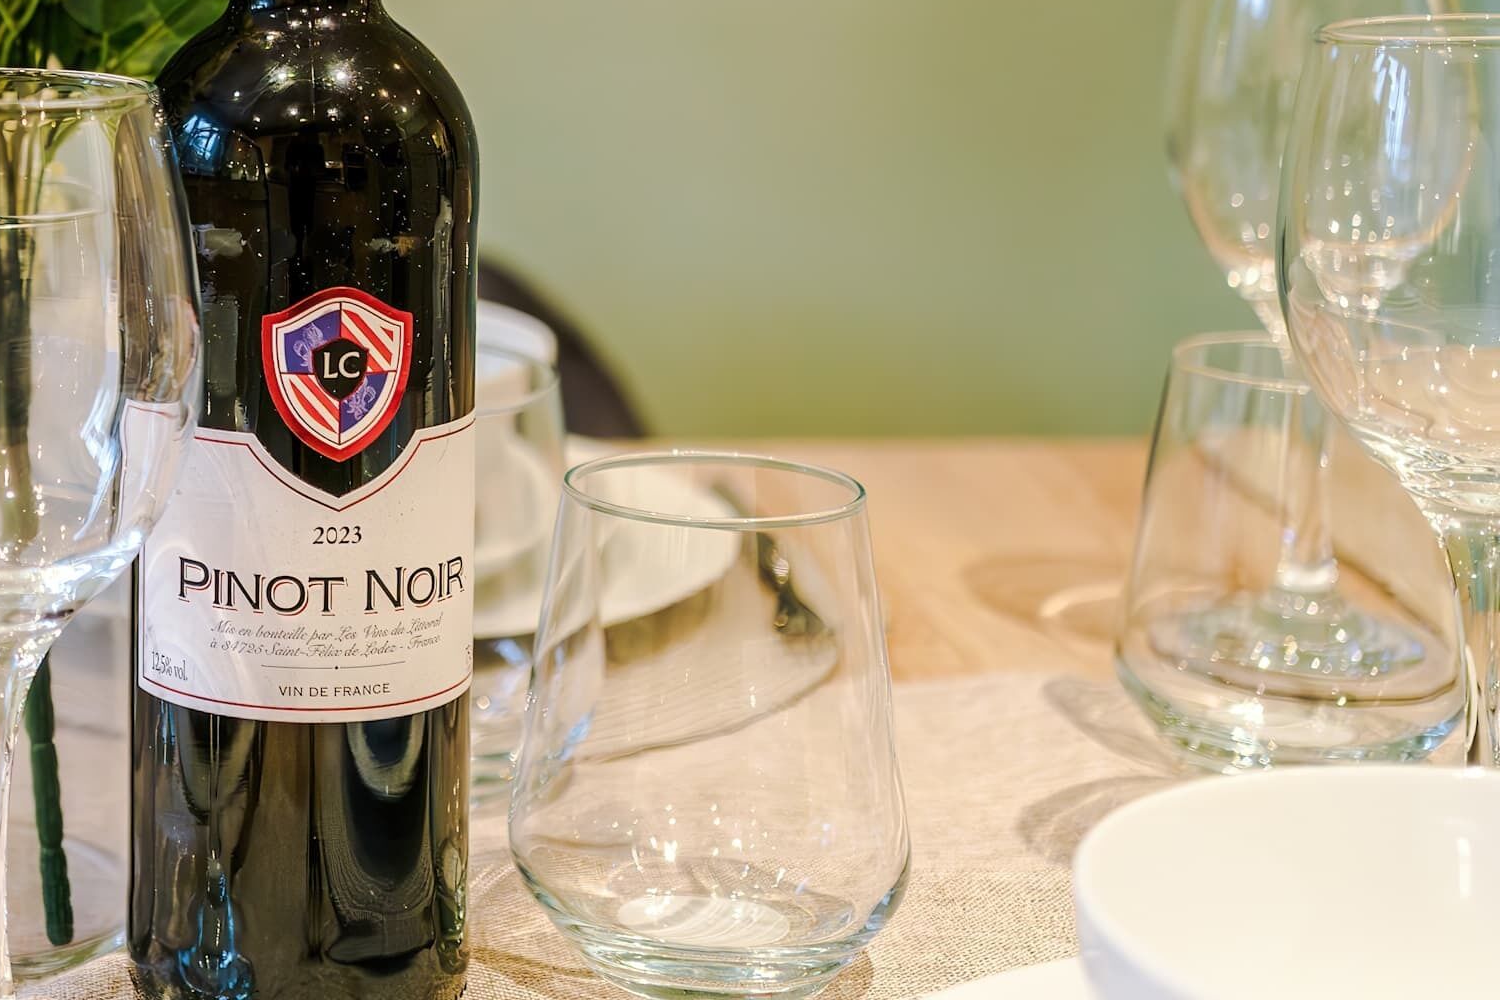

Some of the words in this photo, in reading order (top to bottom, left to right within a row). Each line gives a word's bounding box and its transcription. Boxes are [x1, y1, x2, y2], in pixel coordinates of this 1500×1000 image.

[323, 351, 361, 379] LC
[312, 526, 363, 545] 2023
[178, 556, 347, 616] PINOT
[364, 555, 466, 615] NOIR
[239, 627, 252, 637] en
[255, 624, 307, 641] bouteille
[306, 629, 333, 646] par
[344, 642, 359, 657] de
[278, 685, 303, 697] VIN
[309, 686, 328, 697] DE
[334, 683, 391, 697] FRANCE
